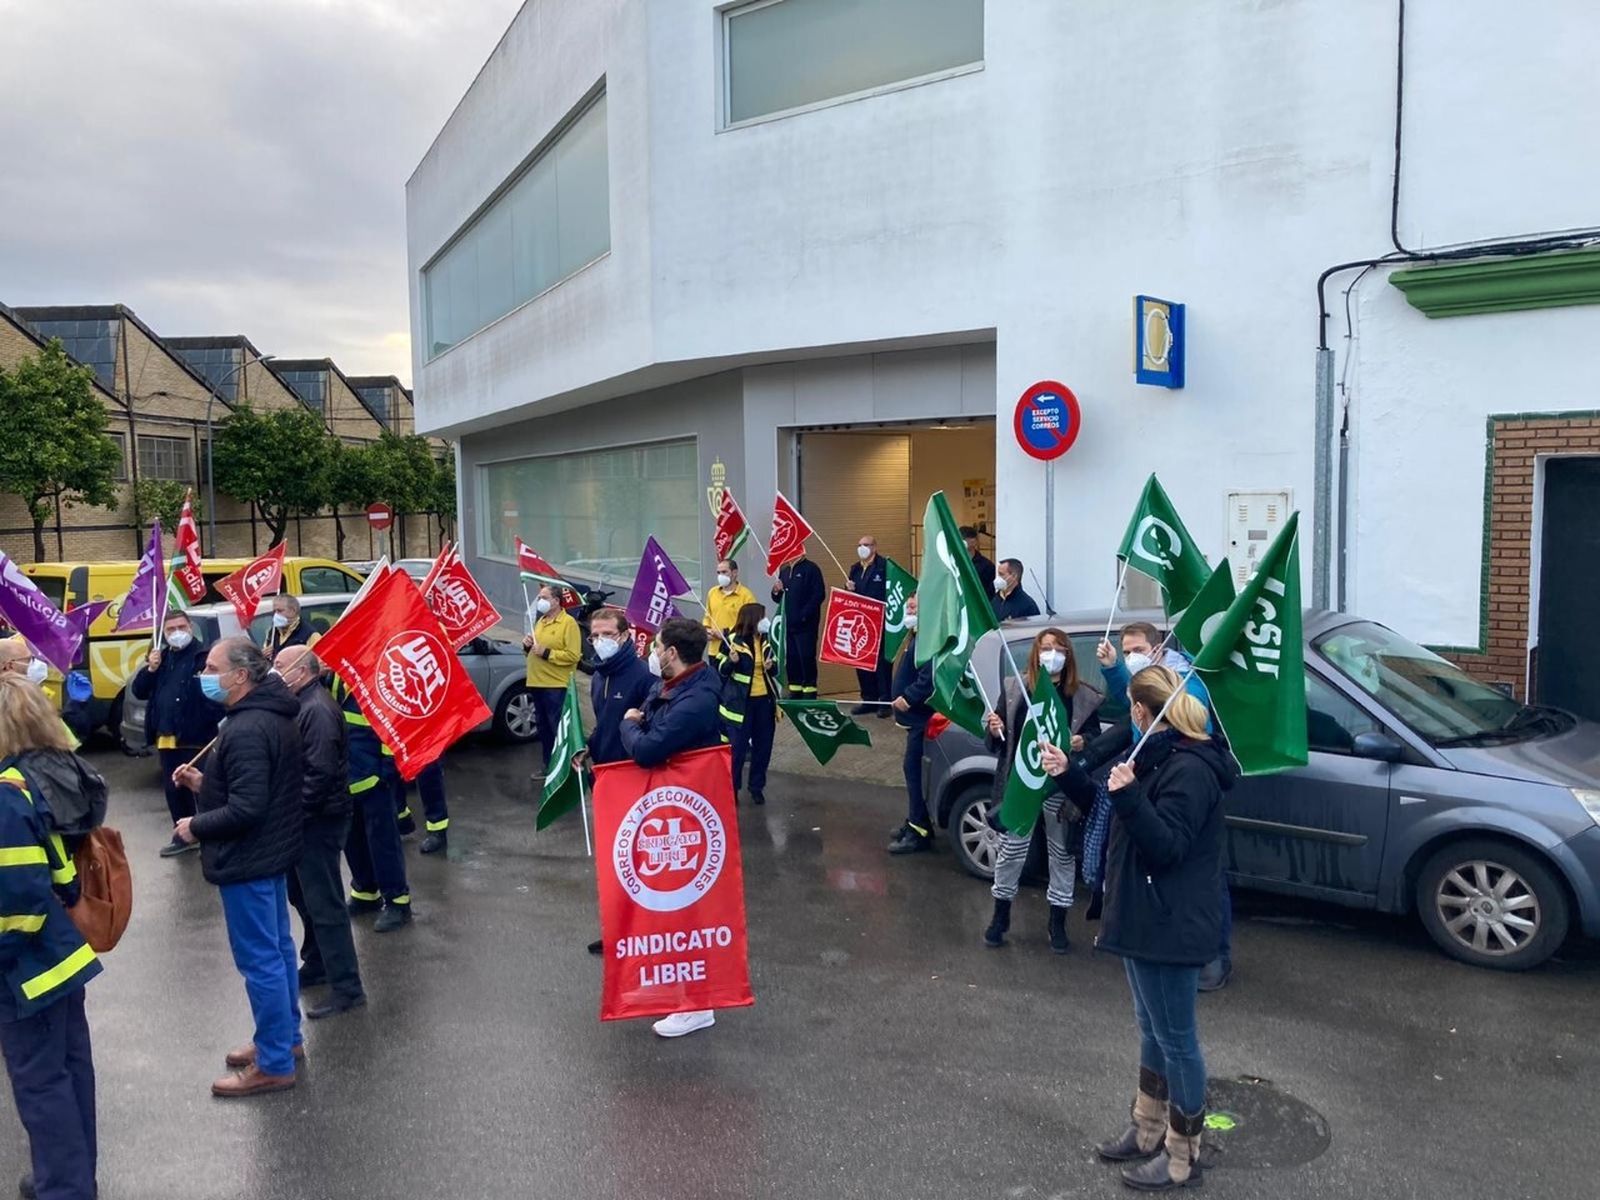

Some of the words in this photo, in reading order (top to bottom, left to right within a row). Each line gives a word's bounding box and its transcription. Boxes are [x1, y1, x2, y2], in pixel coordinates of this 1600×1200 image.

[1031, 422, 1060, 430] CORREOS
[1032, 408, 1059, 416] EXCEPTO
[1032, 415, 1059, 423] SERVICIO
[446, 580, 477, 616] UGT
[885, 580, 905, 622] CSIF
[834, 616, 855, 655] UGT
[401, 635, 447, 697] UGT
[627, 816, 637, 826] Y
[634, 790, 722, 891] TELECOMUNICACIONES
[618, 828, 641, 895] CORREOS
[615, 925, 733, 959] SINDICATO
[639, 959, 707, 987] LIBRE
